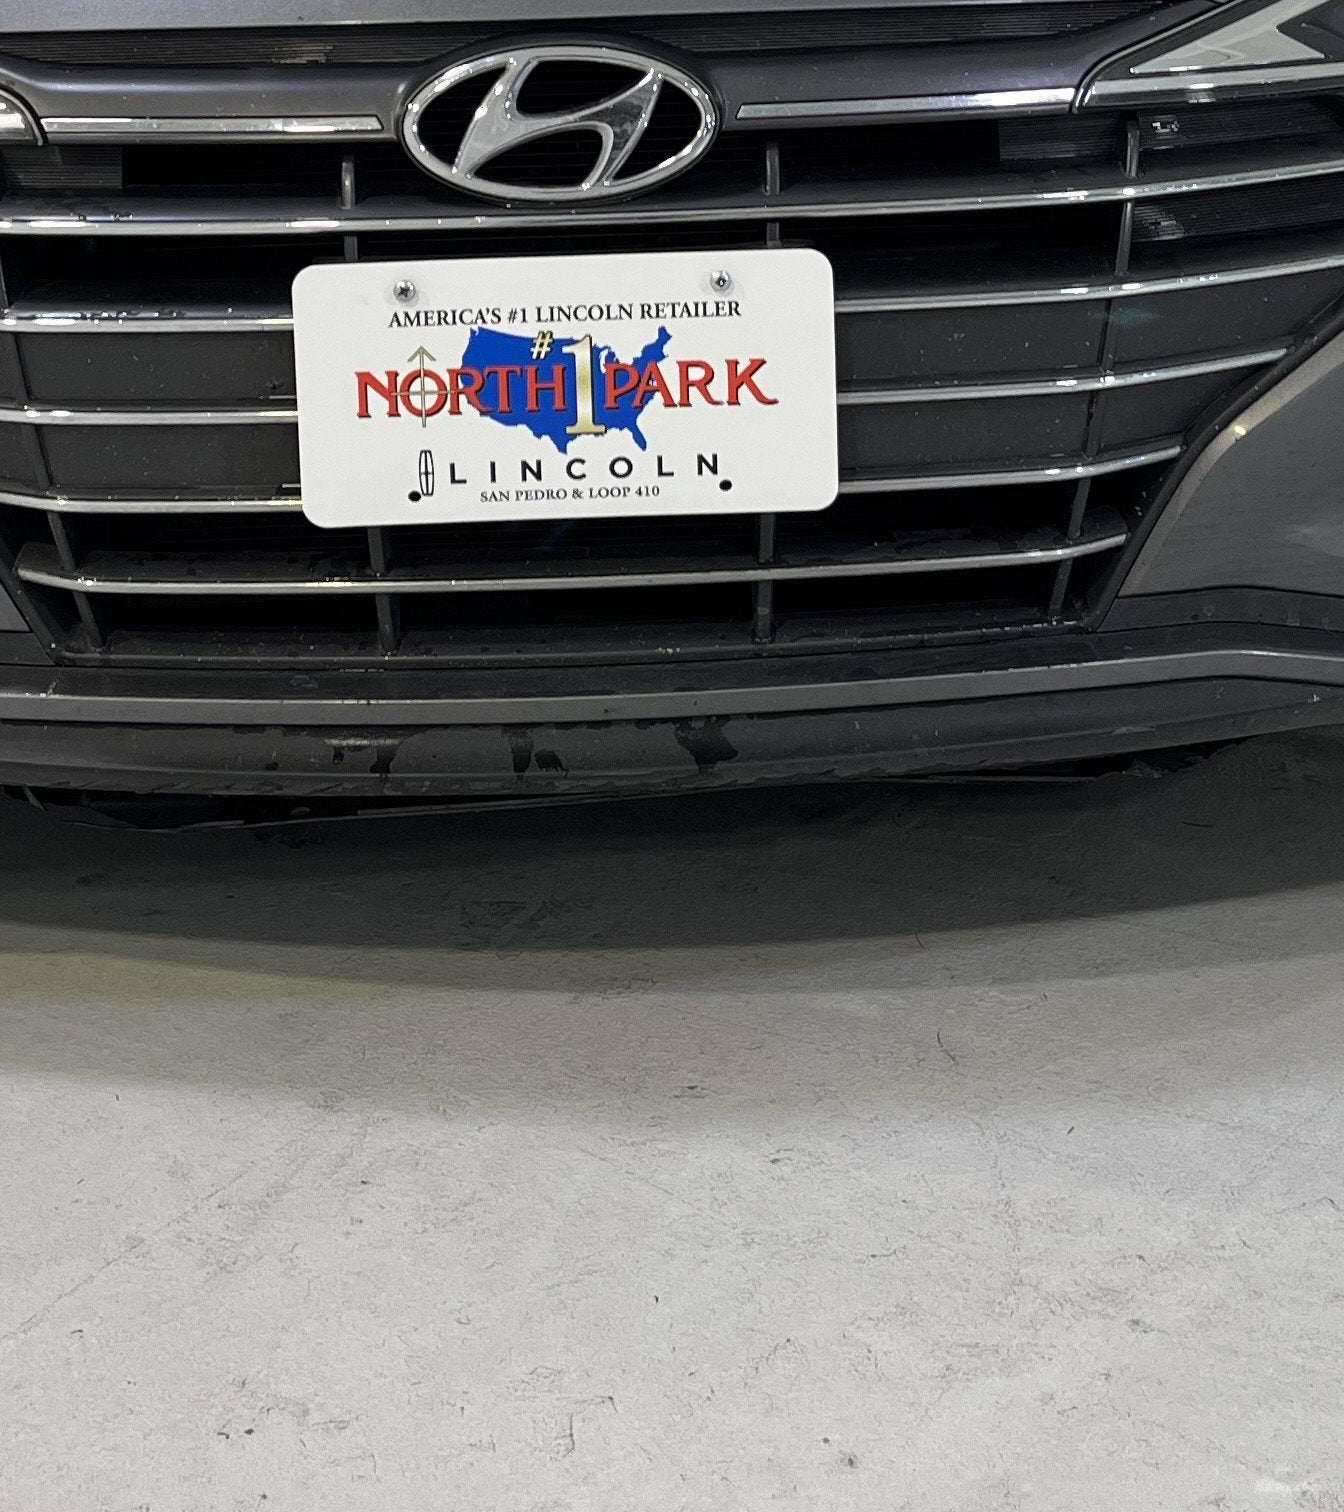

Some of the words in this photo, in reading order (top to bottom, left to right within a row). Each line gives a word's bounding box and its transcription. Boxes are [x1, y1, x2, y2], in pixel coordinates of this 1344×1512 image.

[388, 307, 503, 329] AMERICA'S
[507, 305, 528, 324] #1
[535, 301, 634, 324] LINCOLN
[640, 299, 742, 320] RETAILER
[355, 364, 566, 418] NORTH
[603, 357, 779, 409] PARK
[449, 453, 719, 485] LINCOLN
[479, 490, 511, 503] SAN
[514, 488, 568, 502] PEDRO
[572, 487, 584, 500] &
[588, 486, 631, 500] LOOP
[635, 485, 660, 498] 410
